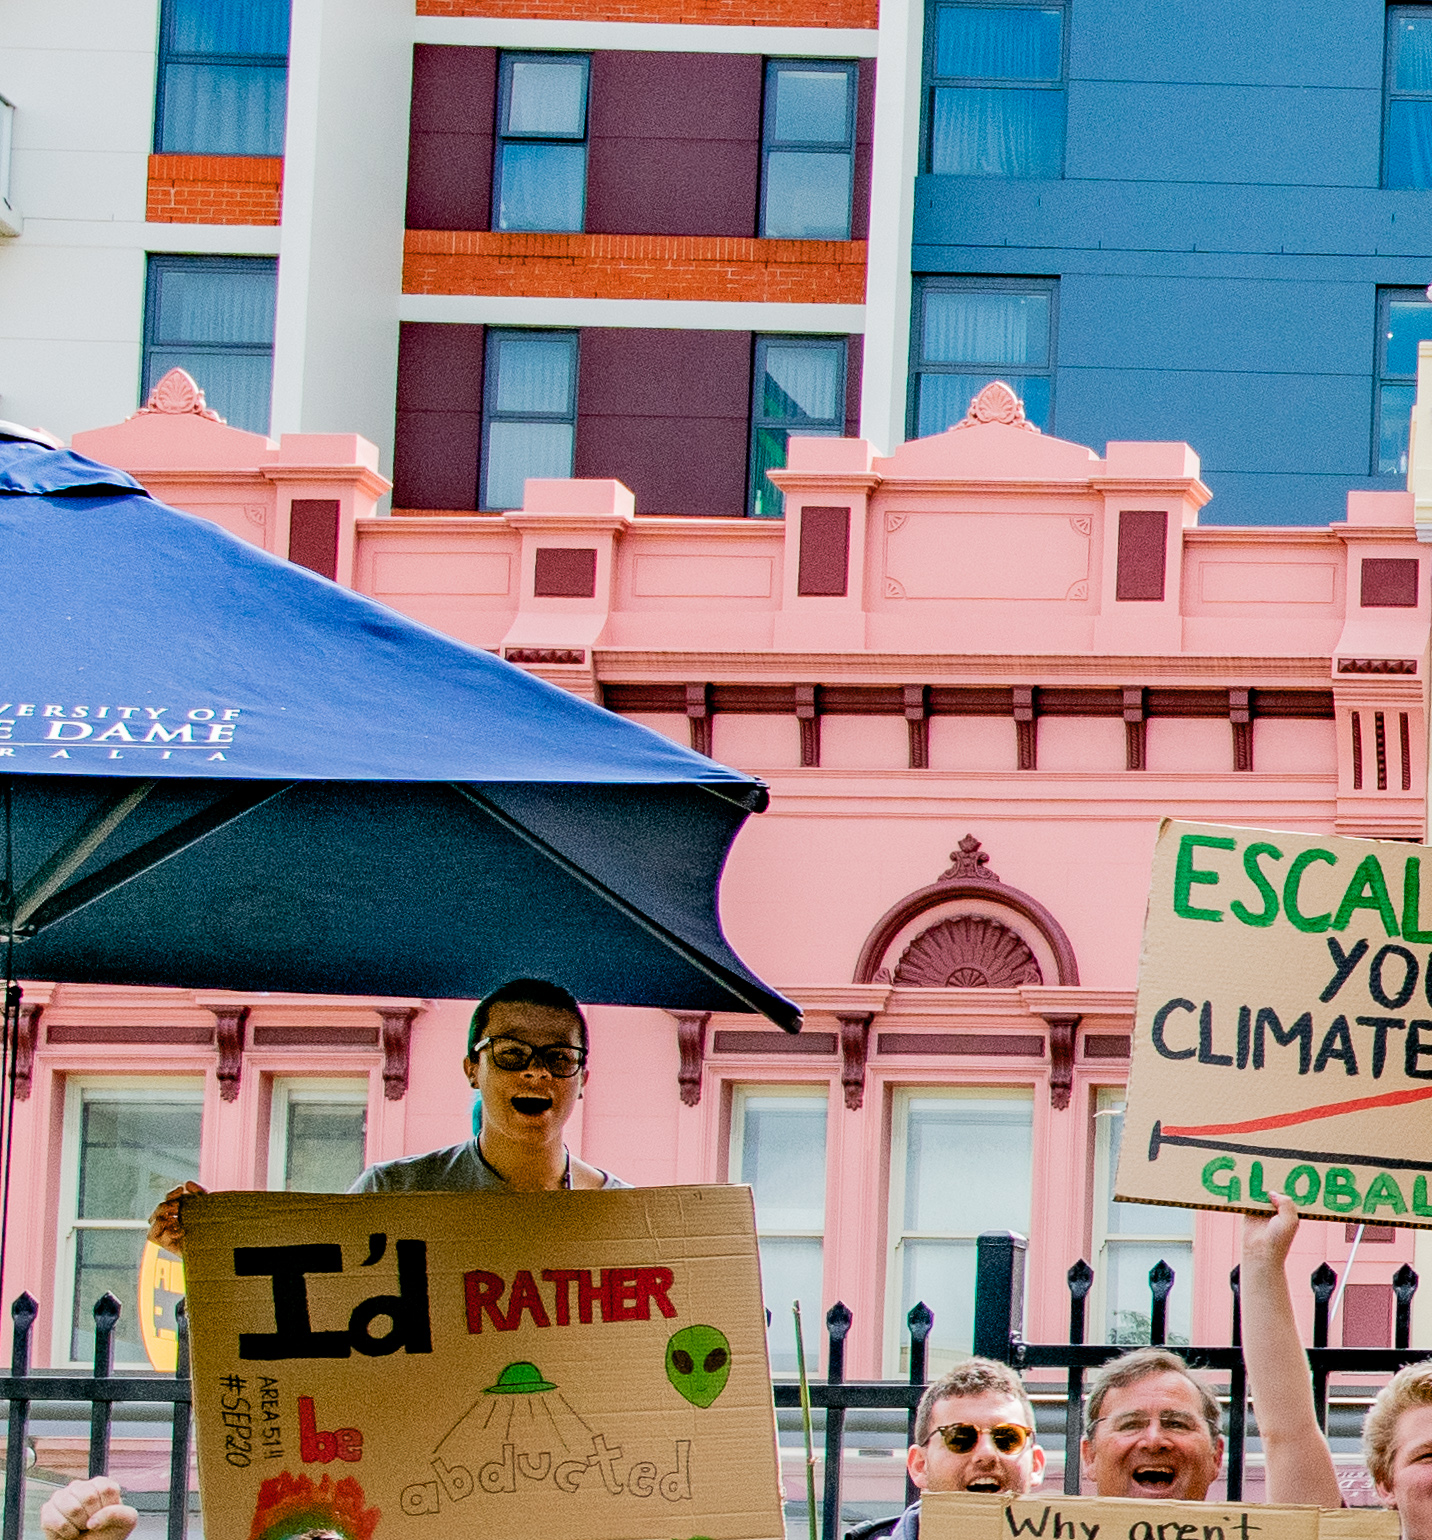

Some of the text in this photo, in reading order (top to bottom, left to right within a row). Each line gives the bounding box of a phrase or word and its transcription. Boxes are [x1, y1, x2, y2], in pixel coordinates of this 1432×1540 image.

[44, 721, 237, 743] DAME
[187, 708, 241, 721] OF
[233, 1232, 433, 1360] I'd
[463, 1266, 677, 1335] RATHER
[219, 1374, 252, 1468] #SEP20
[257, 1376, 280, 1422] AREA
[298, 1397, 364, 1464] be
[400, 1434, 692, 1516] abducted
